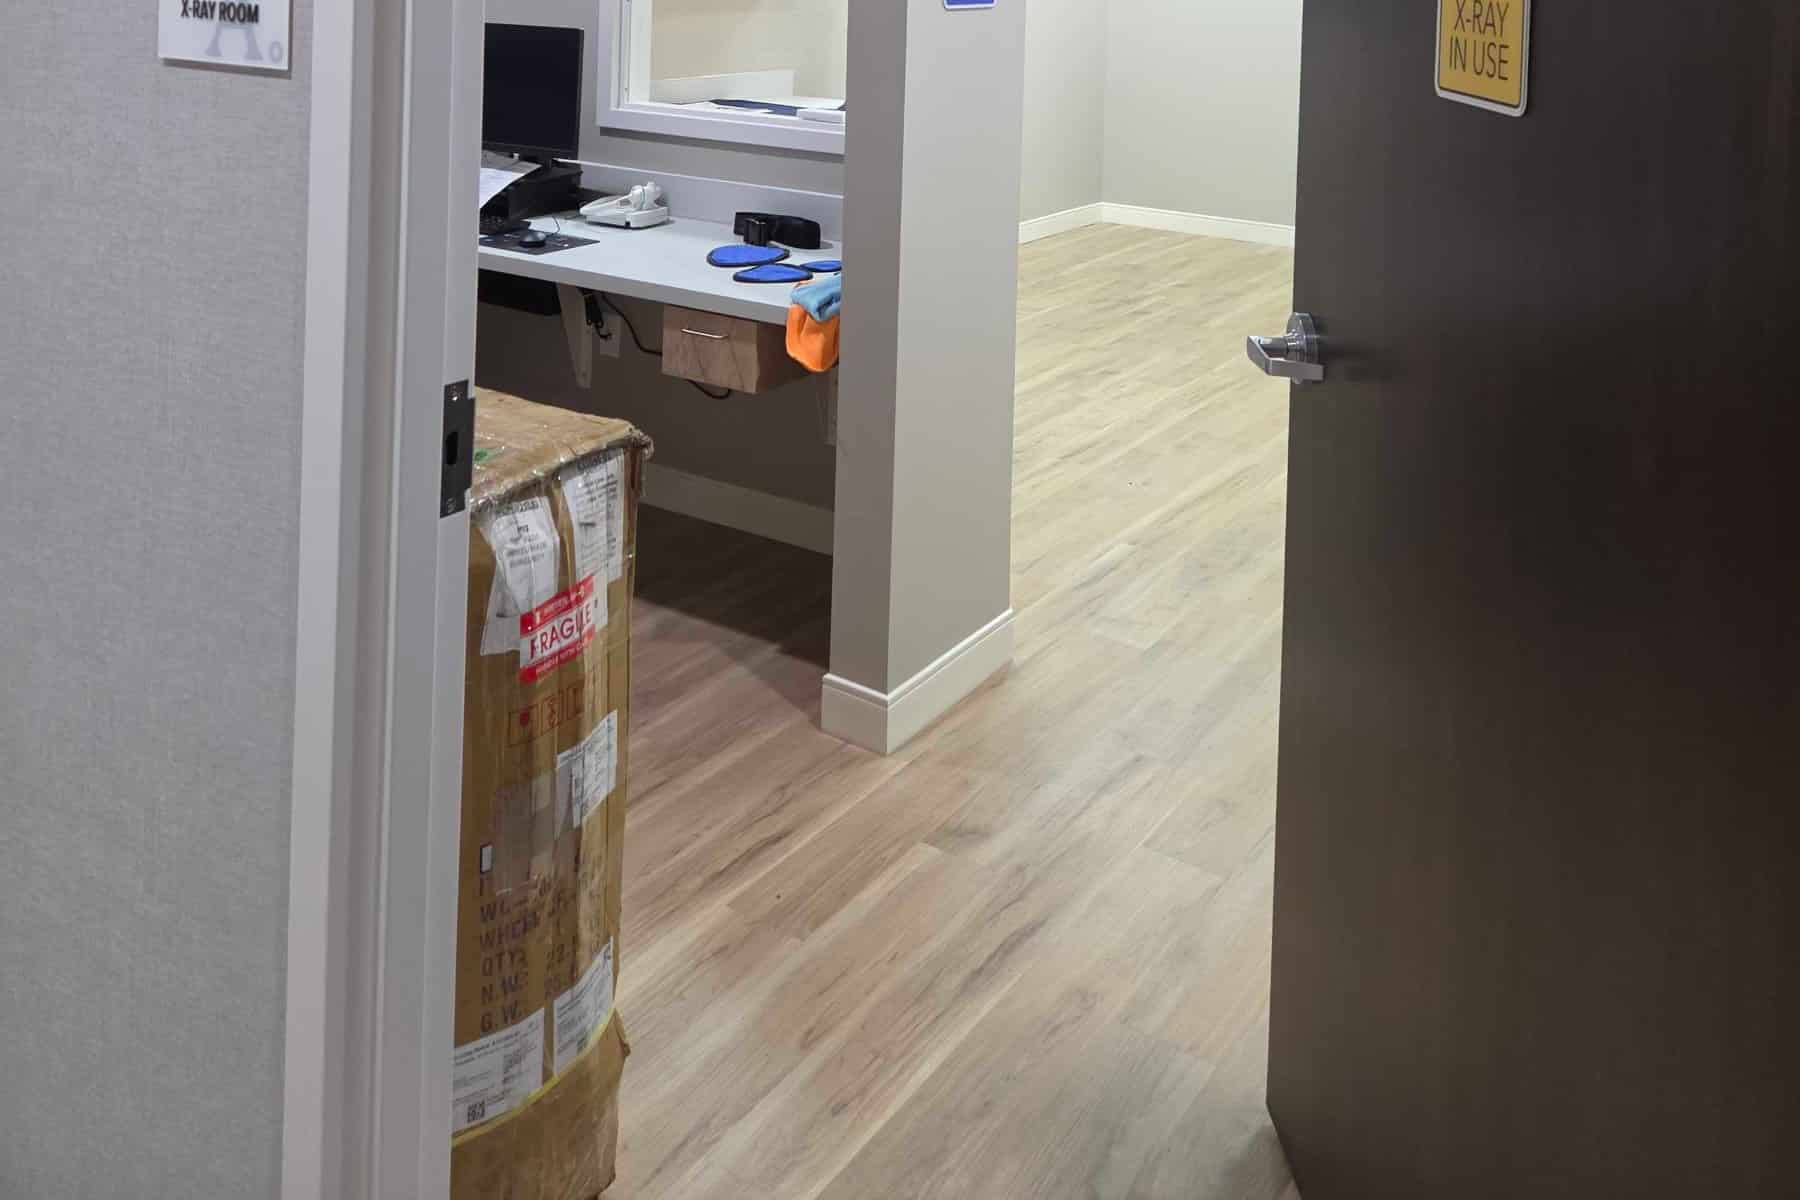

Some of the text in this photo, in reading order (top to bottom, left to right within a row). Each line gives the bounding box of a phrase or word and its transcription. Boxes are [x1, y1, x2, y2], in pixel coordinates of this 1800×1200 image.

[218, 1, 260, 24] ROOM
[1449, 34, 1510, 81] IN USE
